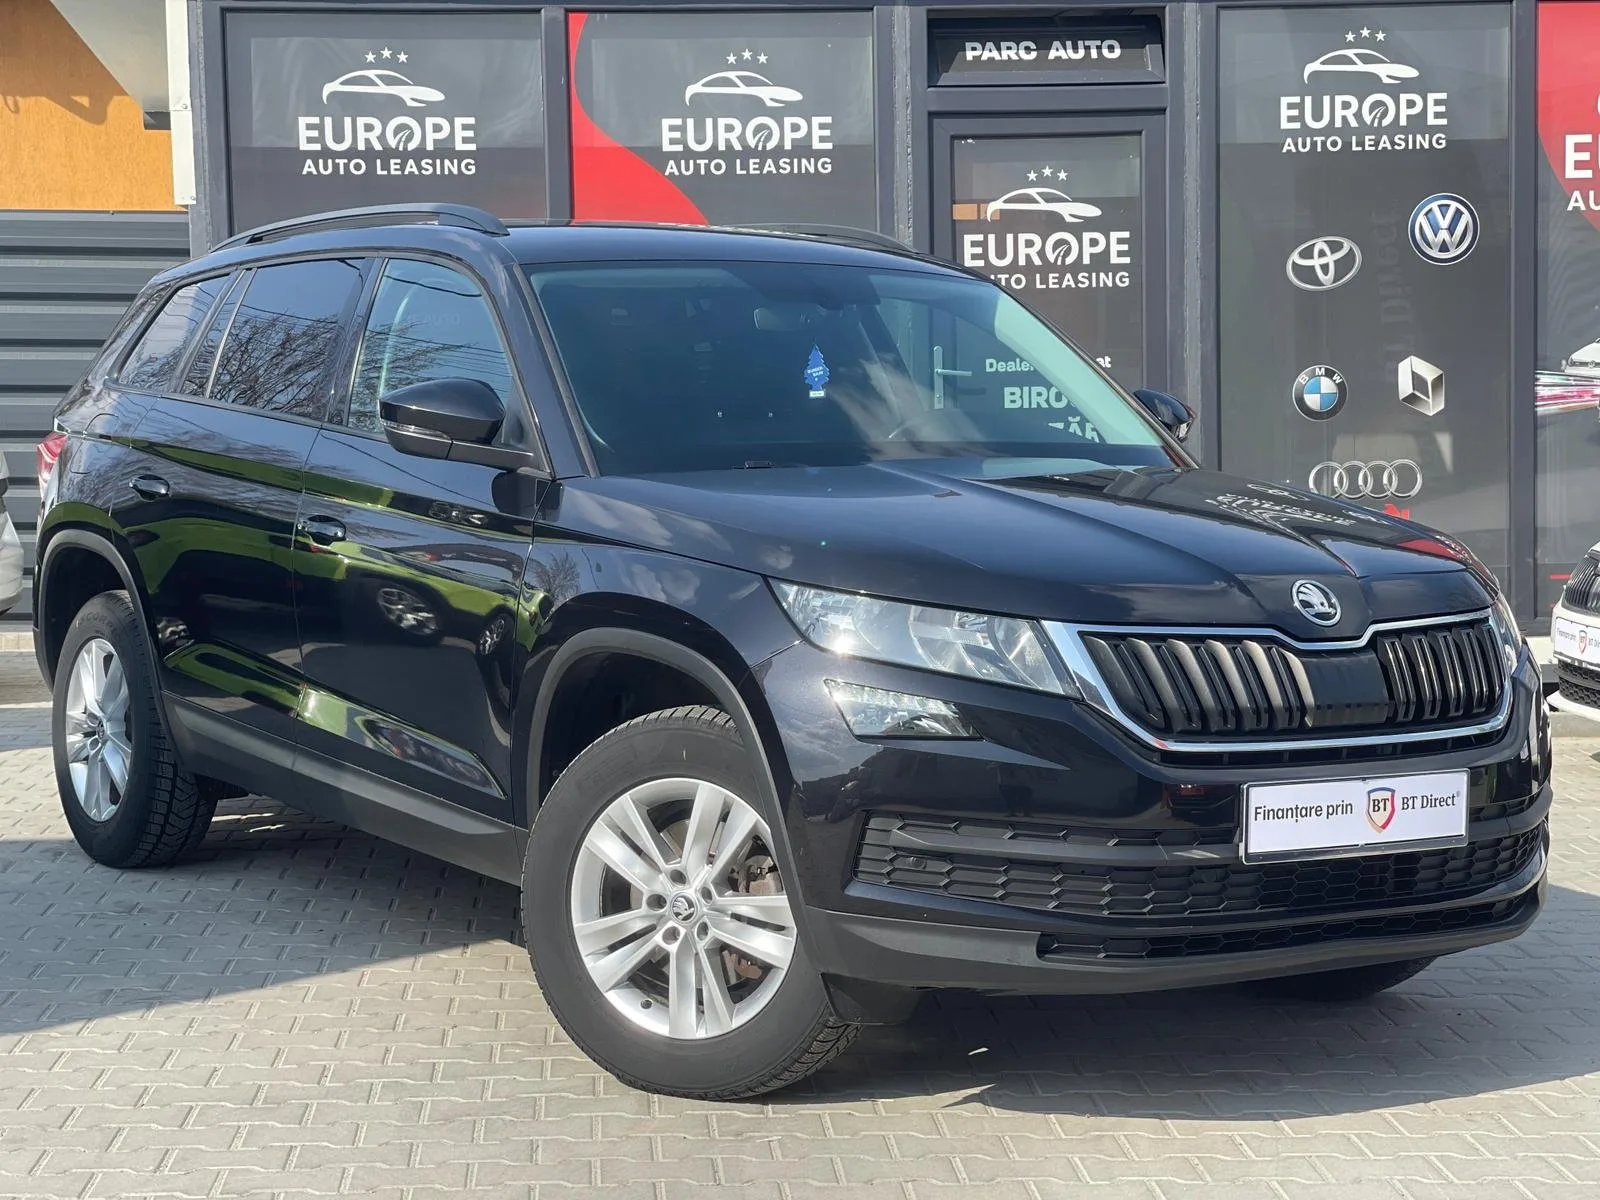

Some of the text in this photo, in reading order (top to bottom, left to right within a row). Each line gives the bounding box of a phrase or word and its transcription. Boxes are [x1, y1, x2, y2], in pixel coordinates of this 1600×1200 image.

[965, 40, 1122, 61] PARC AUTO
[1280, 92, 1448, 130] EUROPE
[297, 115, 477, 152] EUROPE
[661, 115, 833, 152] EUROPE
[1281, 133, 1447, 153] AUTO LEASING
[302, 158, 477, 176] AUTO LEASING
[664, 157, 832, 176] AUTO LEASING
[963, 231, 1131, 268] EUROPE
[1035, 271, 1130, 289] LEASING
[985, 357, 1034, 373] Deale
[1298, 367, 1343, 385] BMW
[1003, 386, 1076, 409] BIRO
[1254, 804, 1324, 823] Finanțare
[1326, 799, 1354, 820] prin
[1401, 795, 1418, 811] BT
[1372, 798, 1390, 813] BT
